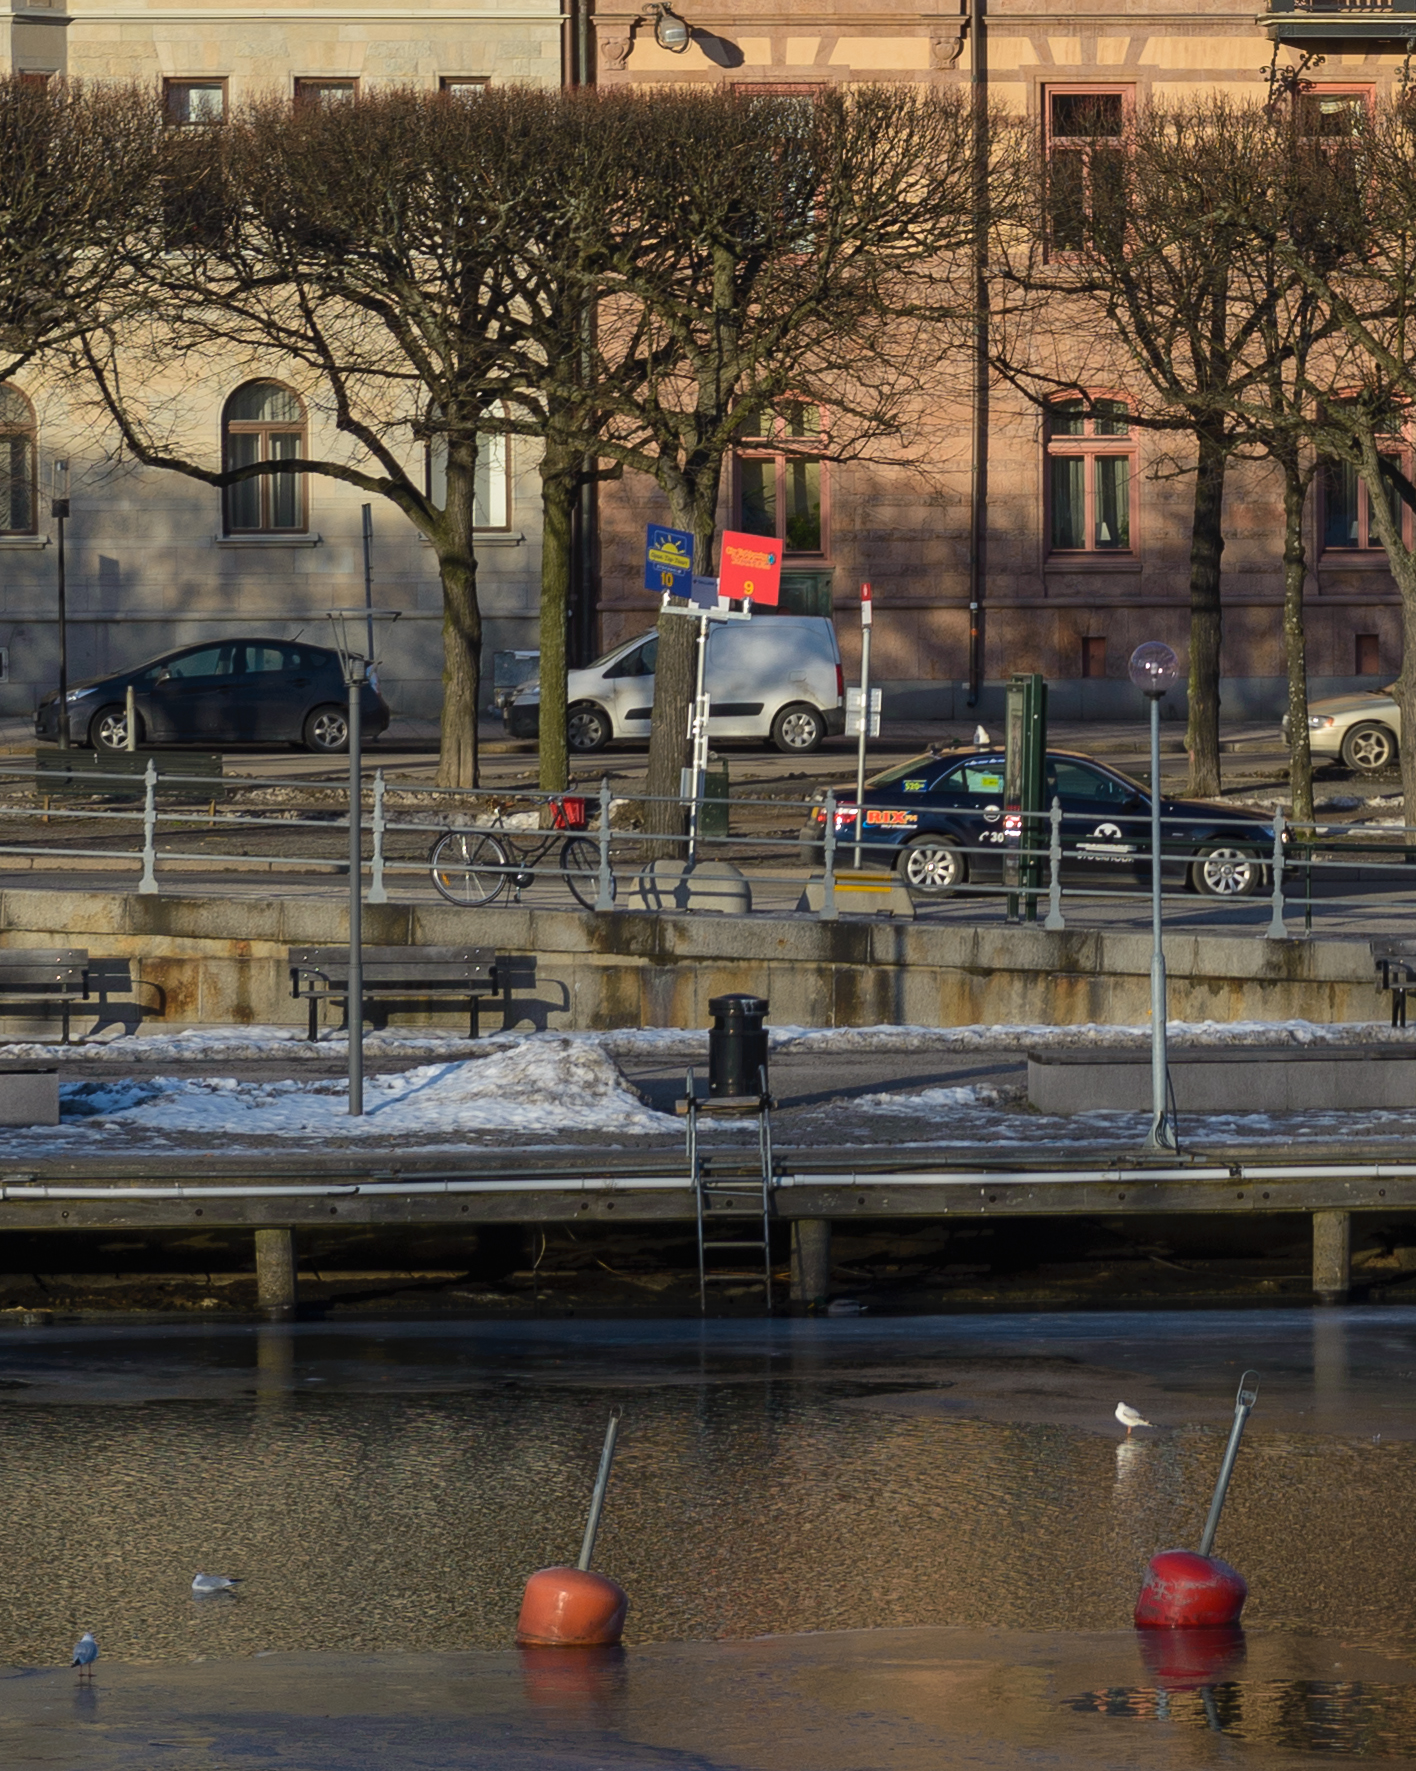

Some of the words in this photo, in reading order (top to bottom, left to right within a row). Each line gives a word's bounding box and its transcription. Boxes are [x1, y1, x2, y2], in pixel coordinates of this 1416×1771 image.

[661, 571, 673, 587] 10
[743, 580, 754, 595] 9
[867, 810, 907, 824] RIX
[990, 832, 1004, 843] 30
